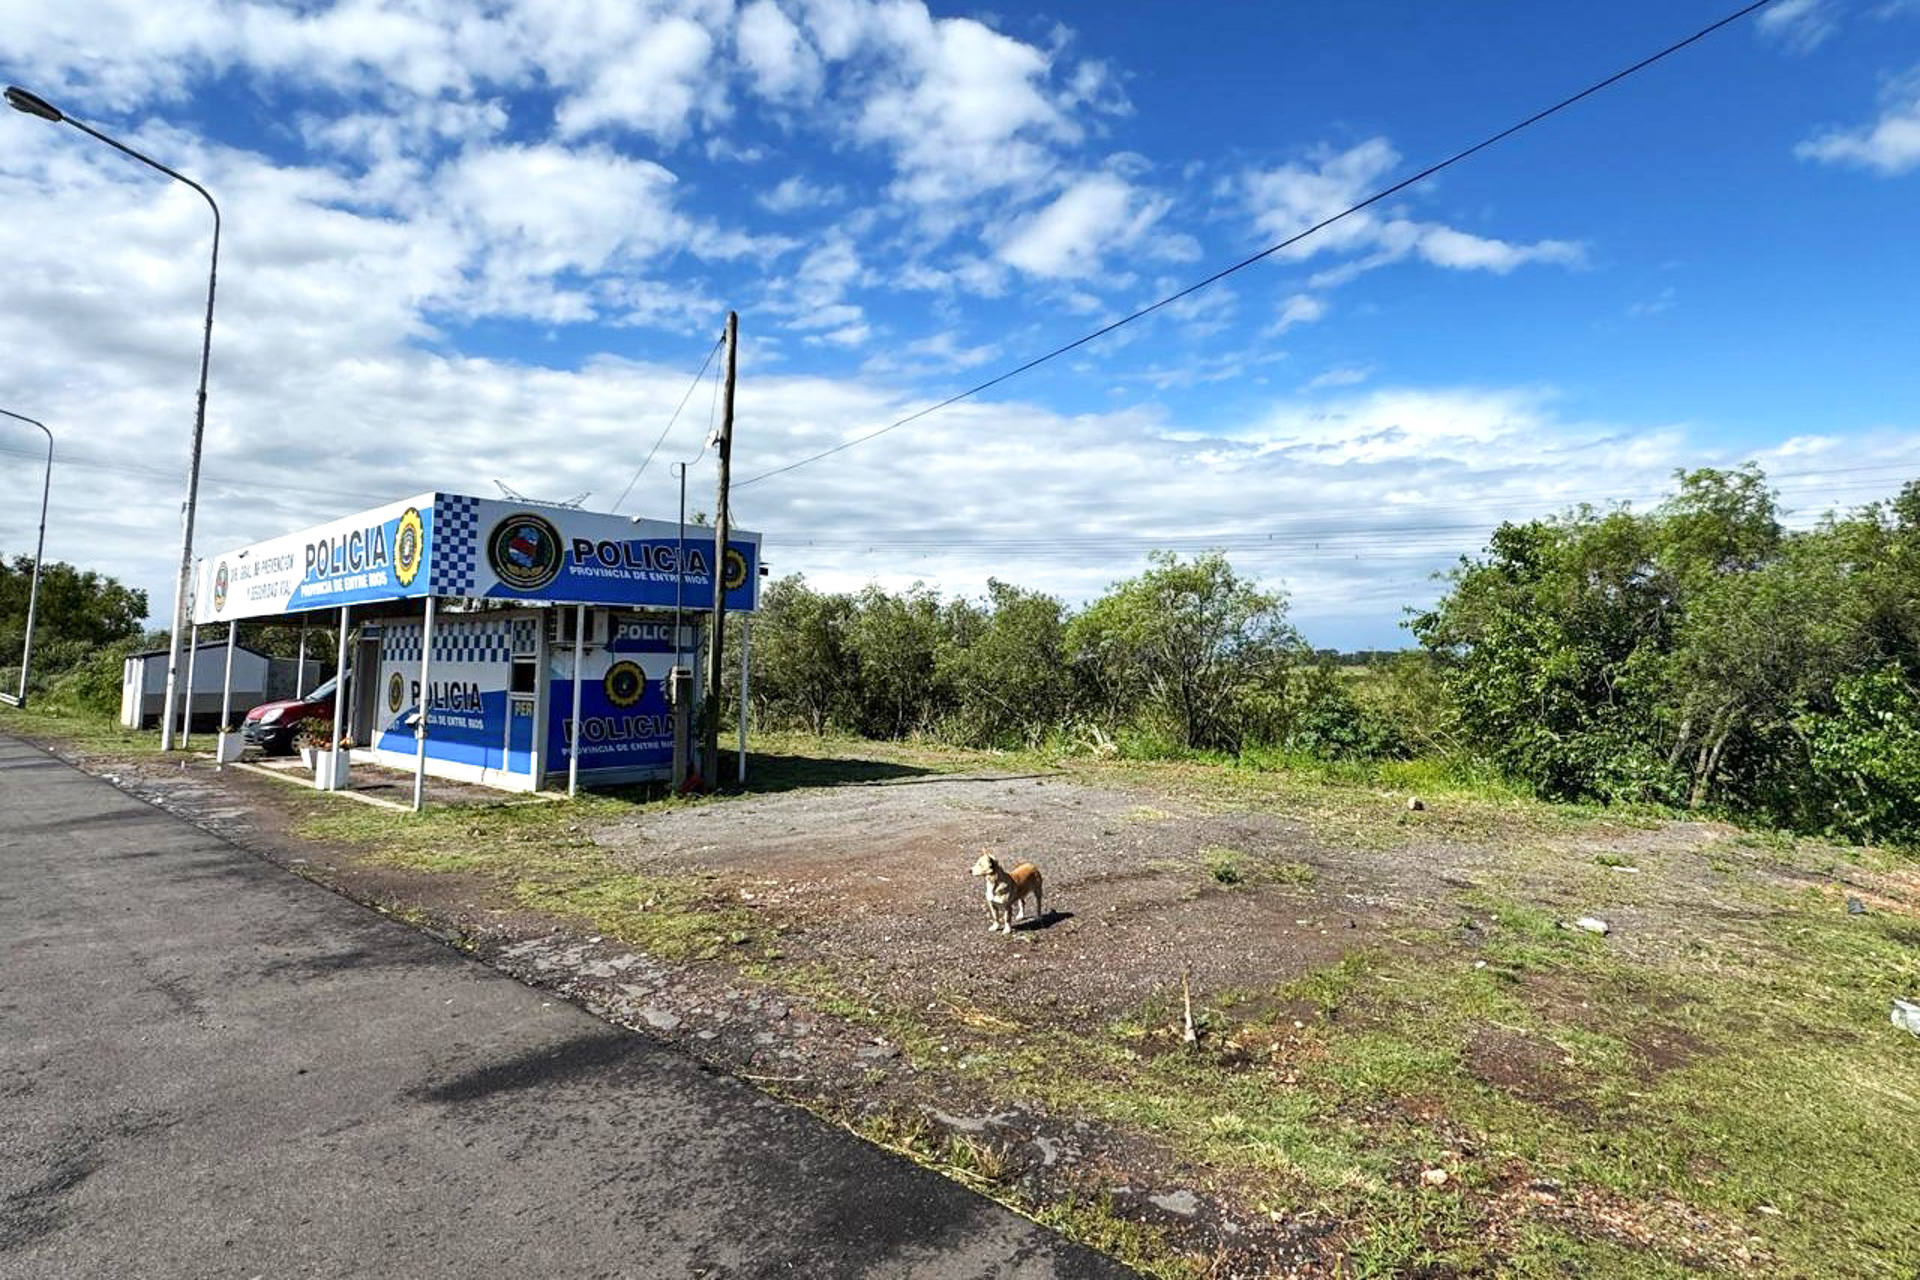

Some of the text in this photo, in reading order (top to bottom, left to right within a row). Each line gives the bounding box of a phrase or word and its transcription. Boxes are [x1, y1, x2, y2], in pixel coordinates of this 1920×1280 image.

[305, 525, 388, 579] POLICIA
[572, 538, 709, 575] POLICIA
[569, 566, 631, 579] PROVINCIA
[632, 571, 648, 580] DE
[617, 624, 670, 640] POLIC
[561, 744, 616, 756] POVINCIA
